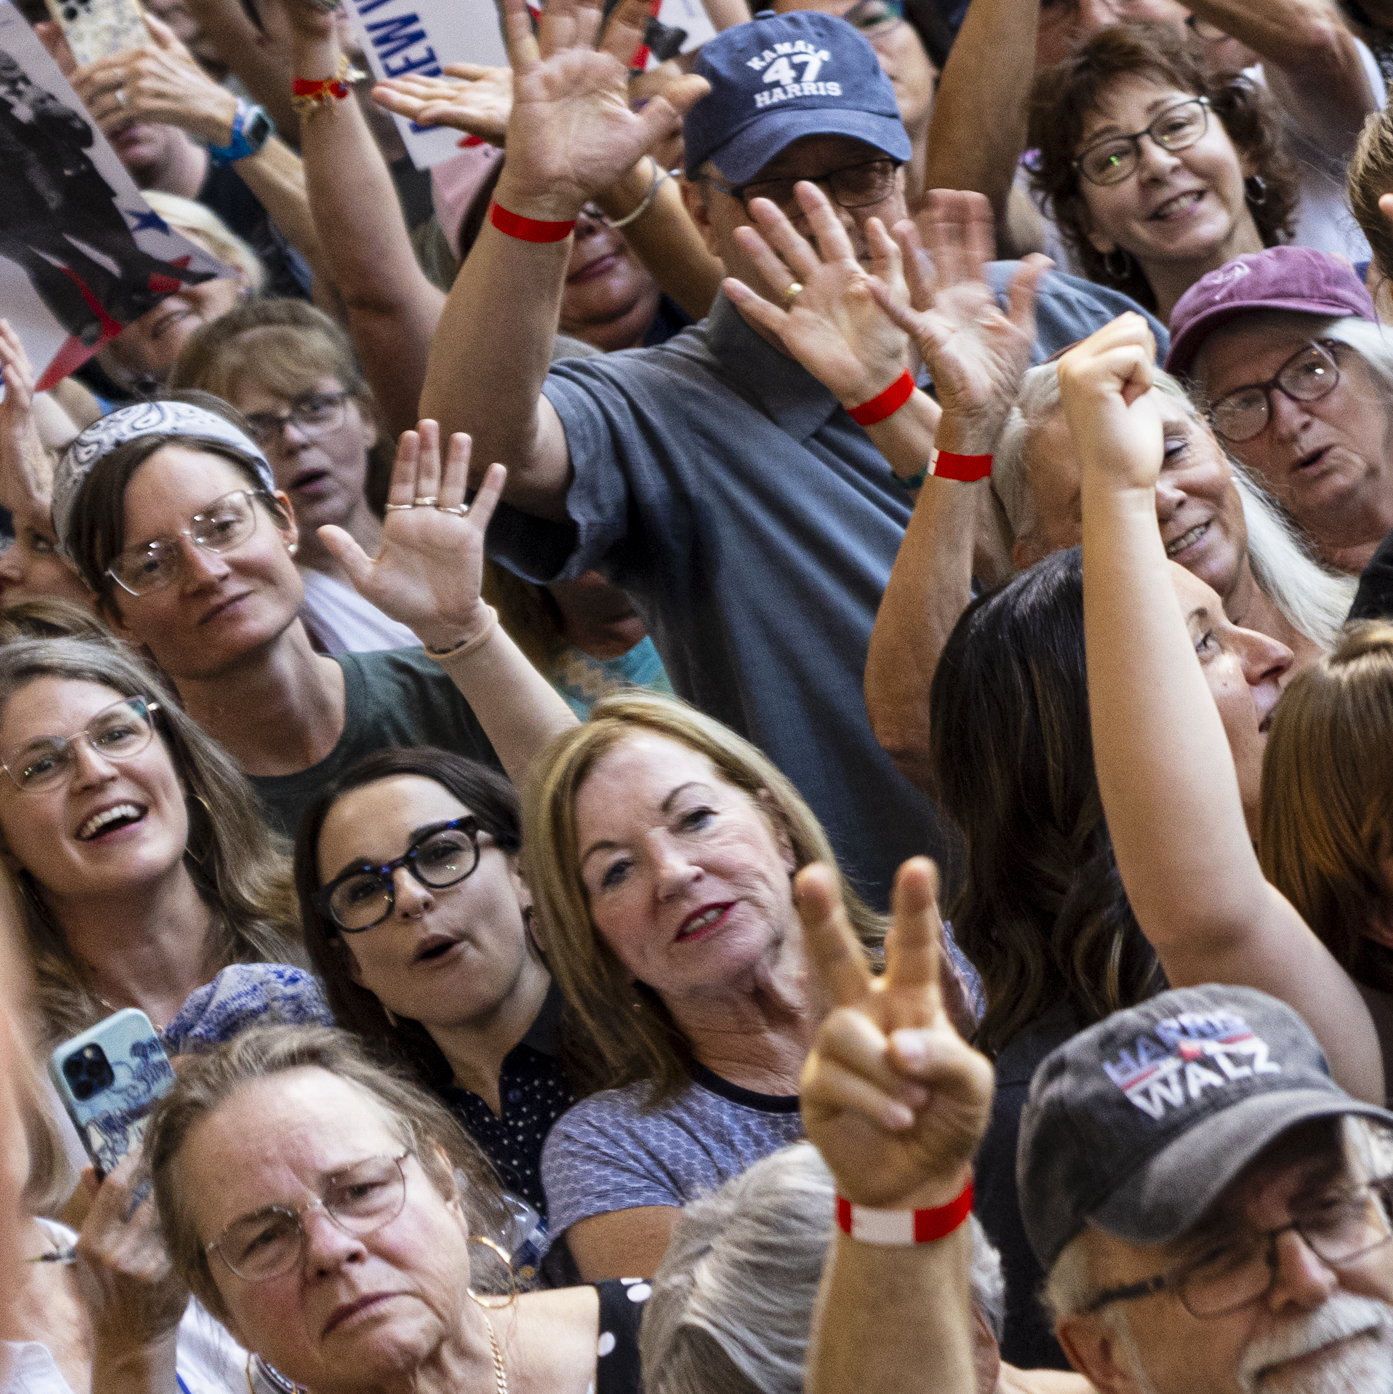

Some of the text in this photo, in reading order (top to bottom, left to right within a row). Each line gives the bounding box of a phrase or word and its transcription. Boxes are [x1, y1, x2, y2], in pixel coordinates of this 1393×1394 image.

[364, 12, 444, 79] EW
[762, 53, 821, 87] 47
[753, 81, 843, 109] HARRIS
[1101, 1008, 1255, 1090] HARRIS
[1125, 1036, 1282, 1121] WALZ
